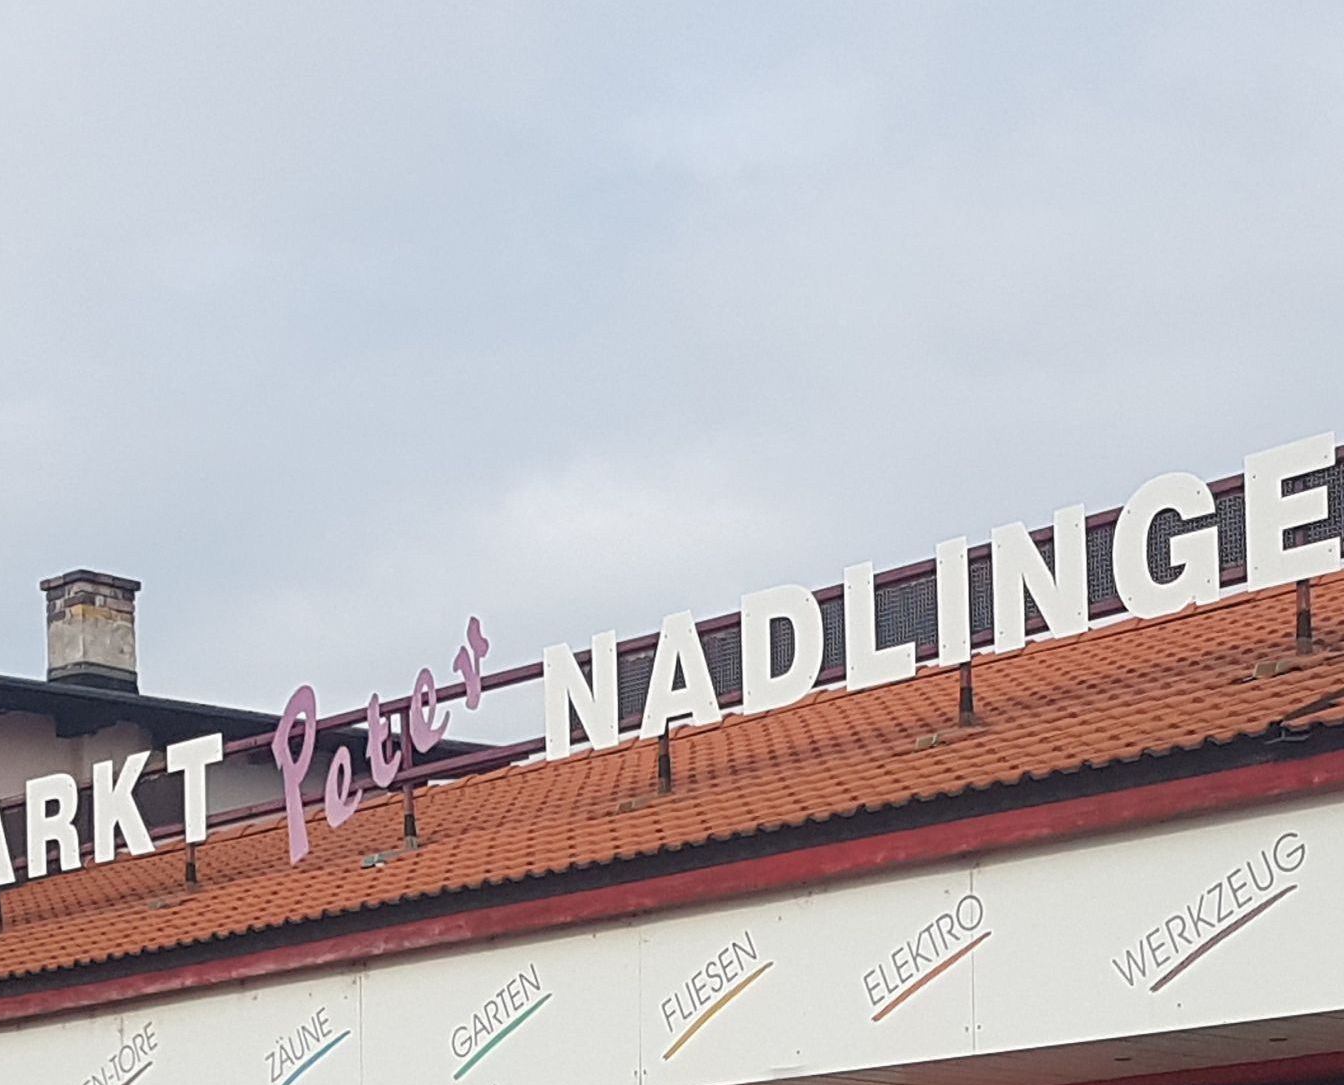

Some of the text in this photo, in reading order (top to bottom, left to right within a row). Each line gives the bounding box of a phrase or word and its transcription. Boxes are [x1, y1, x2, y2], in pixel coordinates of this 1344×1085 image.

[271, 614, 490, 866] Peter
[862, 893, 986, 1010] ELEKTRO
[1111, 831, 1308, 989] WERKZEUG
[449, 962, 542, 1060] GARTEN
[659, 930, 760, 1035] FLIESEN
[263, 1006, 334, 1084] ZÄUNE
